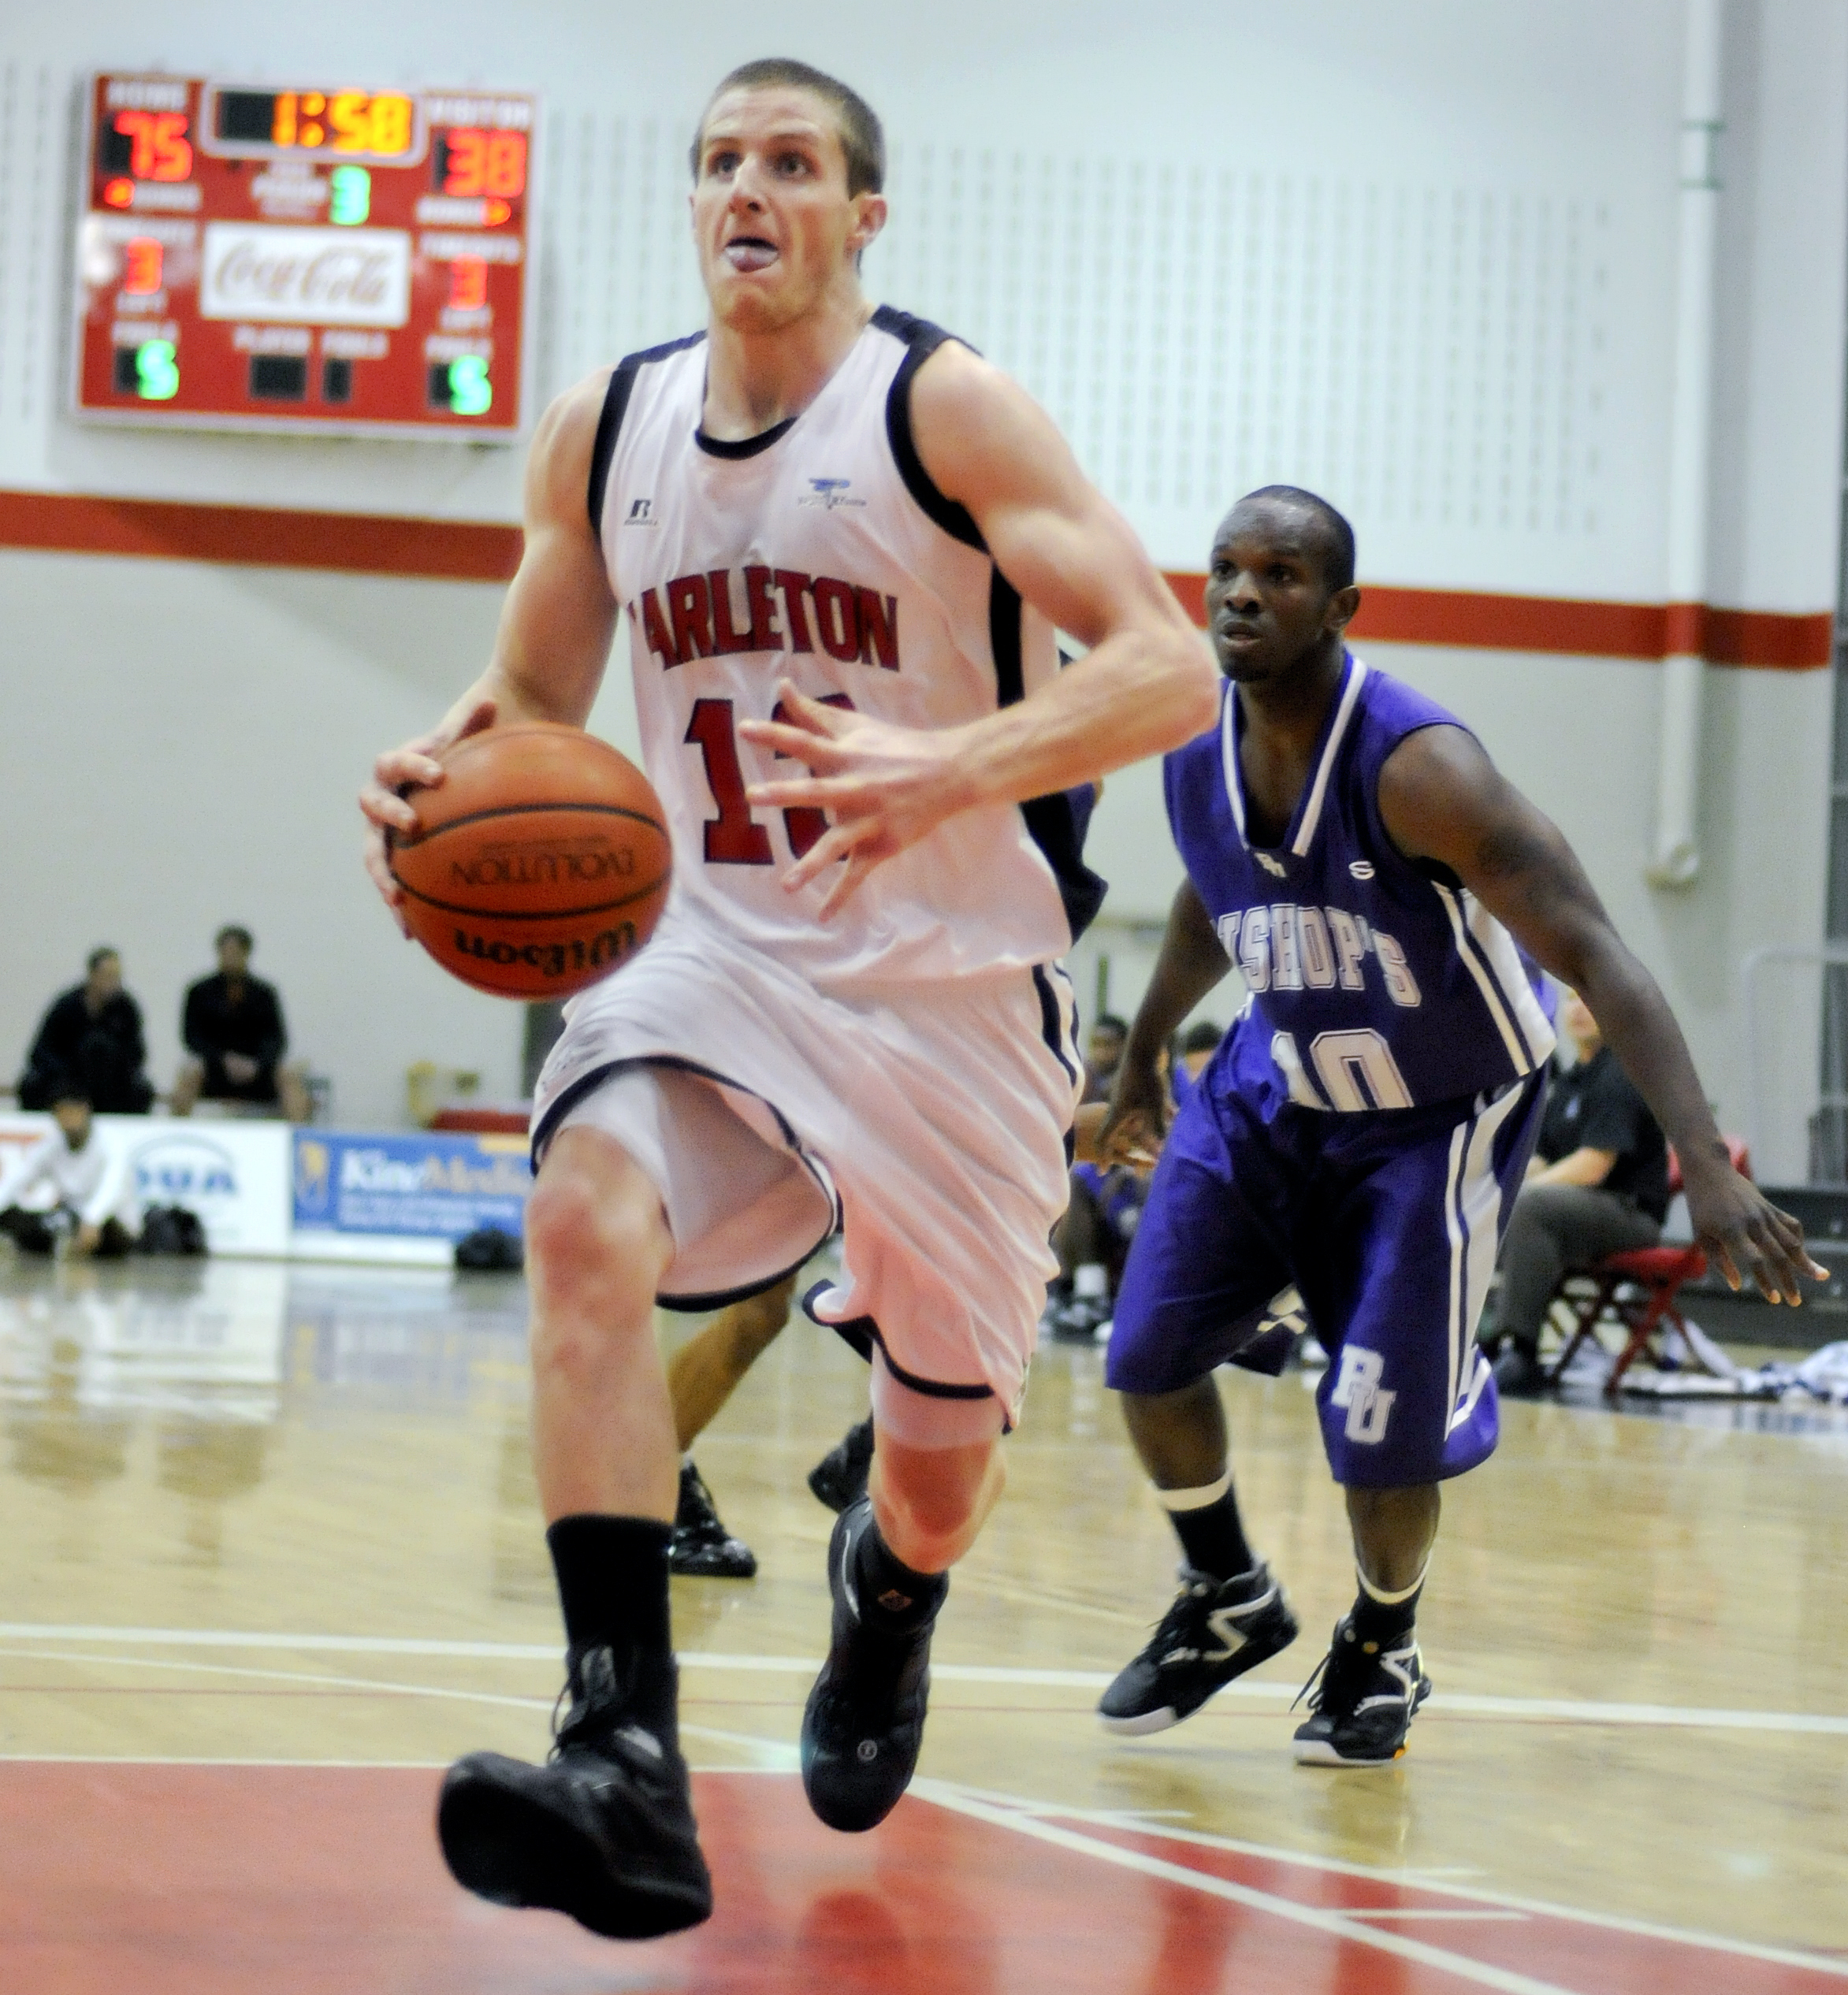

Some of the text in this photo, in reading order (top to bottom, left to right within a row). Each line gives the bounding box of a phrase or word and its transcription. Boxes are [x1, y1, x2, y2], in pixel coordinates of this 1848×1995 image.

[114, 110, 193, 182] 75
[272, 89, 412, 156] 1:58
[444, 127, 527, 197] 38
[329, 165, 370, 225] 3
[125, 237, 163, 295] 3
[450, 254, 487, 310] 3
[136, 339, 180, 399] 5
[448, 355, 492, 415] 5
[628, 565, 900, 671] ARLETON
[453, 920, 638, 977] Wilson
[1212, 903, 1422, 1008] ISHOP'S
[1331, 1343, 1397, 1445] BU
